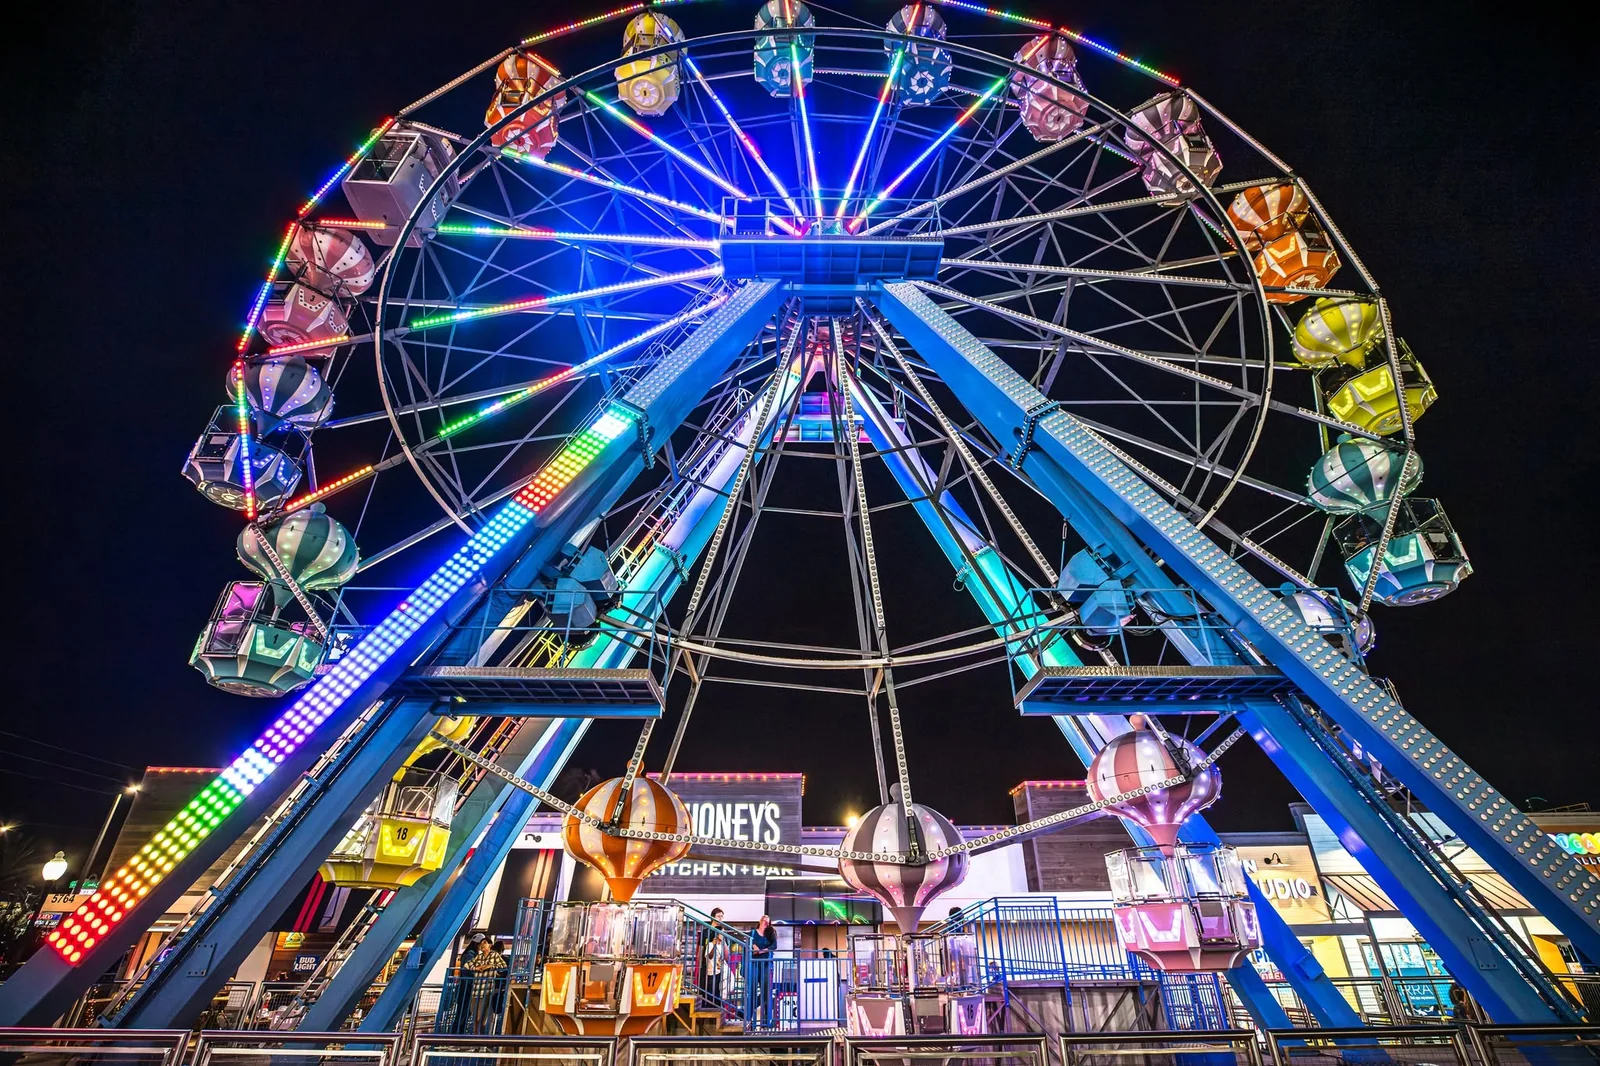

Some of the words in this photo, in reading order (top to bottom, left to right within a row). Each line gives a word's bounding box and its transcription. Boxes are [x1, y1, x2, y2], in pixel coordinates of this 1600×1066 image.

[255, 448, 262, 456] 2
[273, 634, 280, 644] 1
[397, 827, 409, 840] 18
[752, 865, 795, 877] BAR
[1257, 877, 1312, 900] UDIO
[51, 894, 76, 904] 5764
[294, 963, 317, 971] LIGHT
[647, 972, 658, 987] 17
[1397, 984, 1434, 997] RRA
